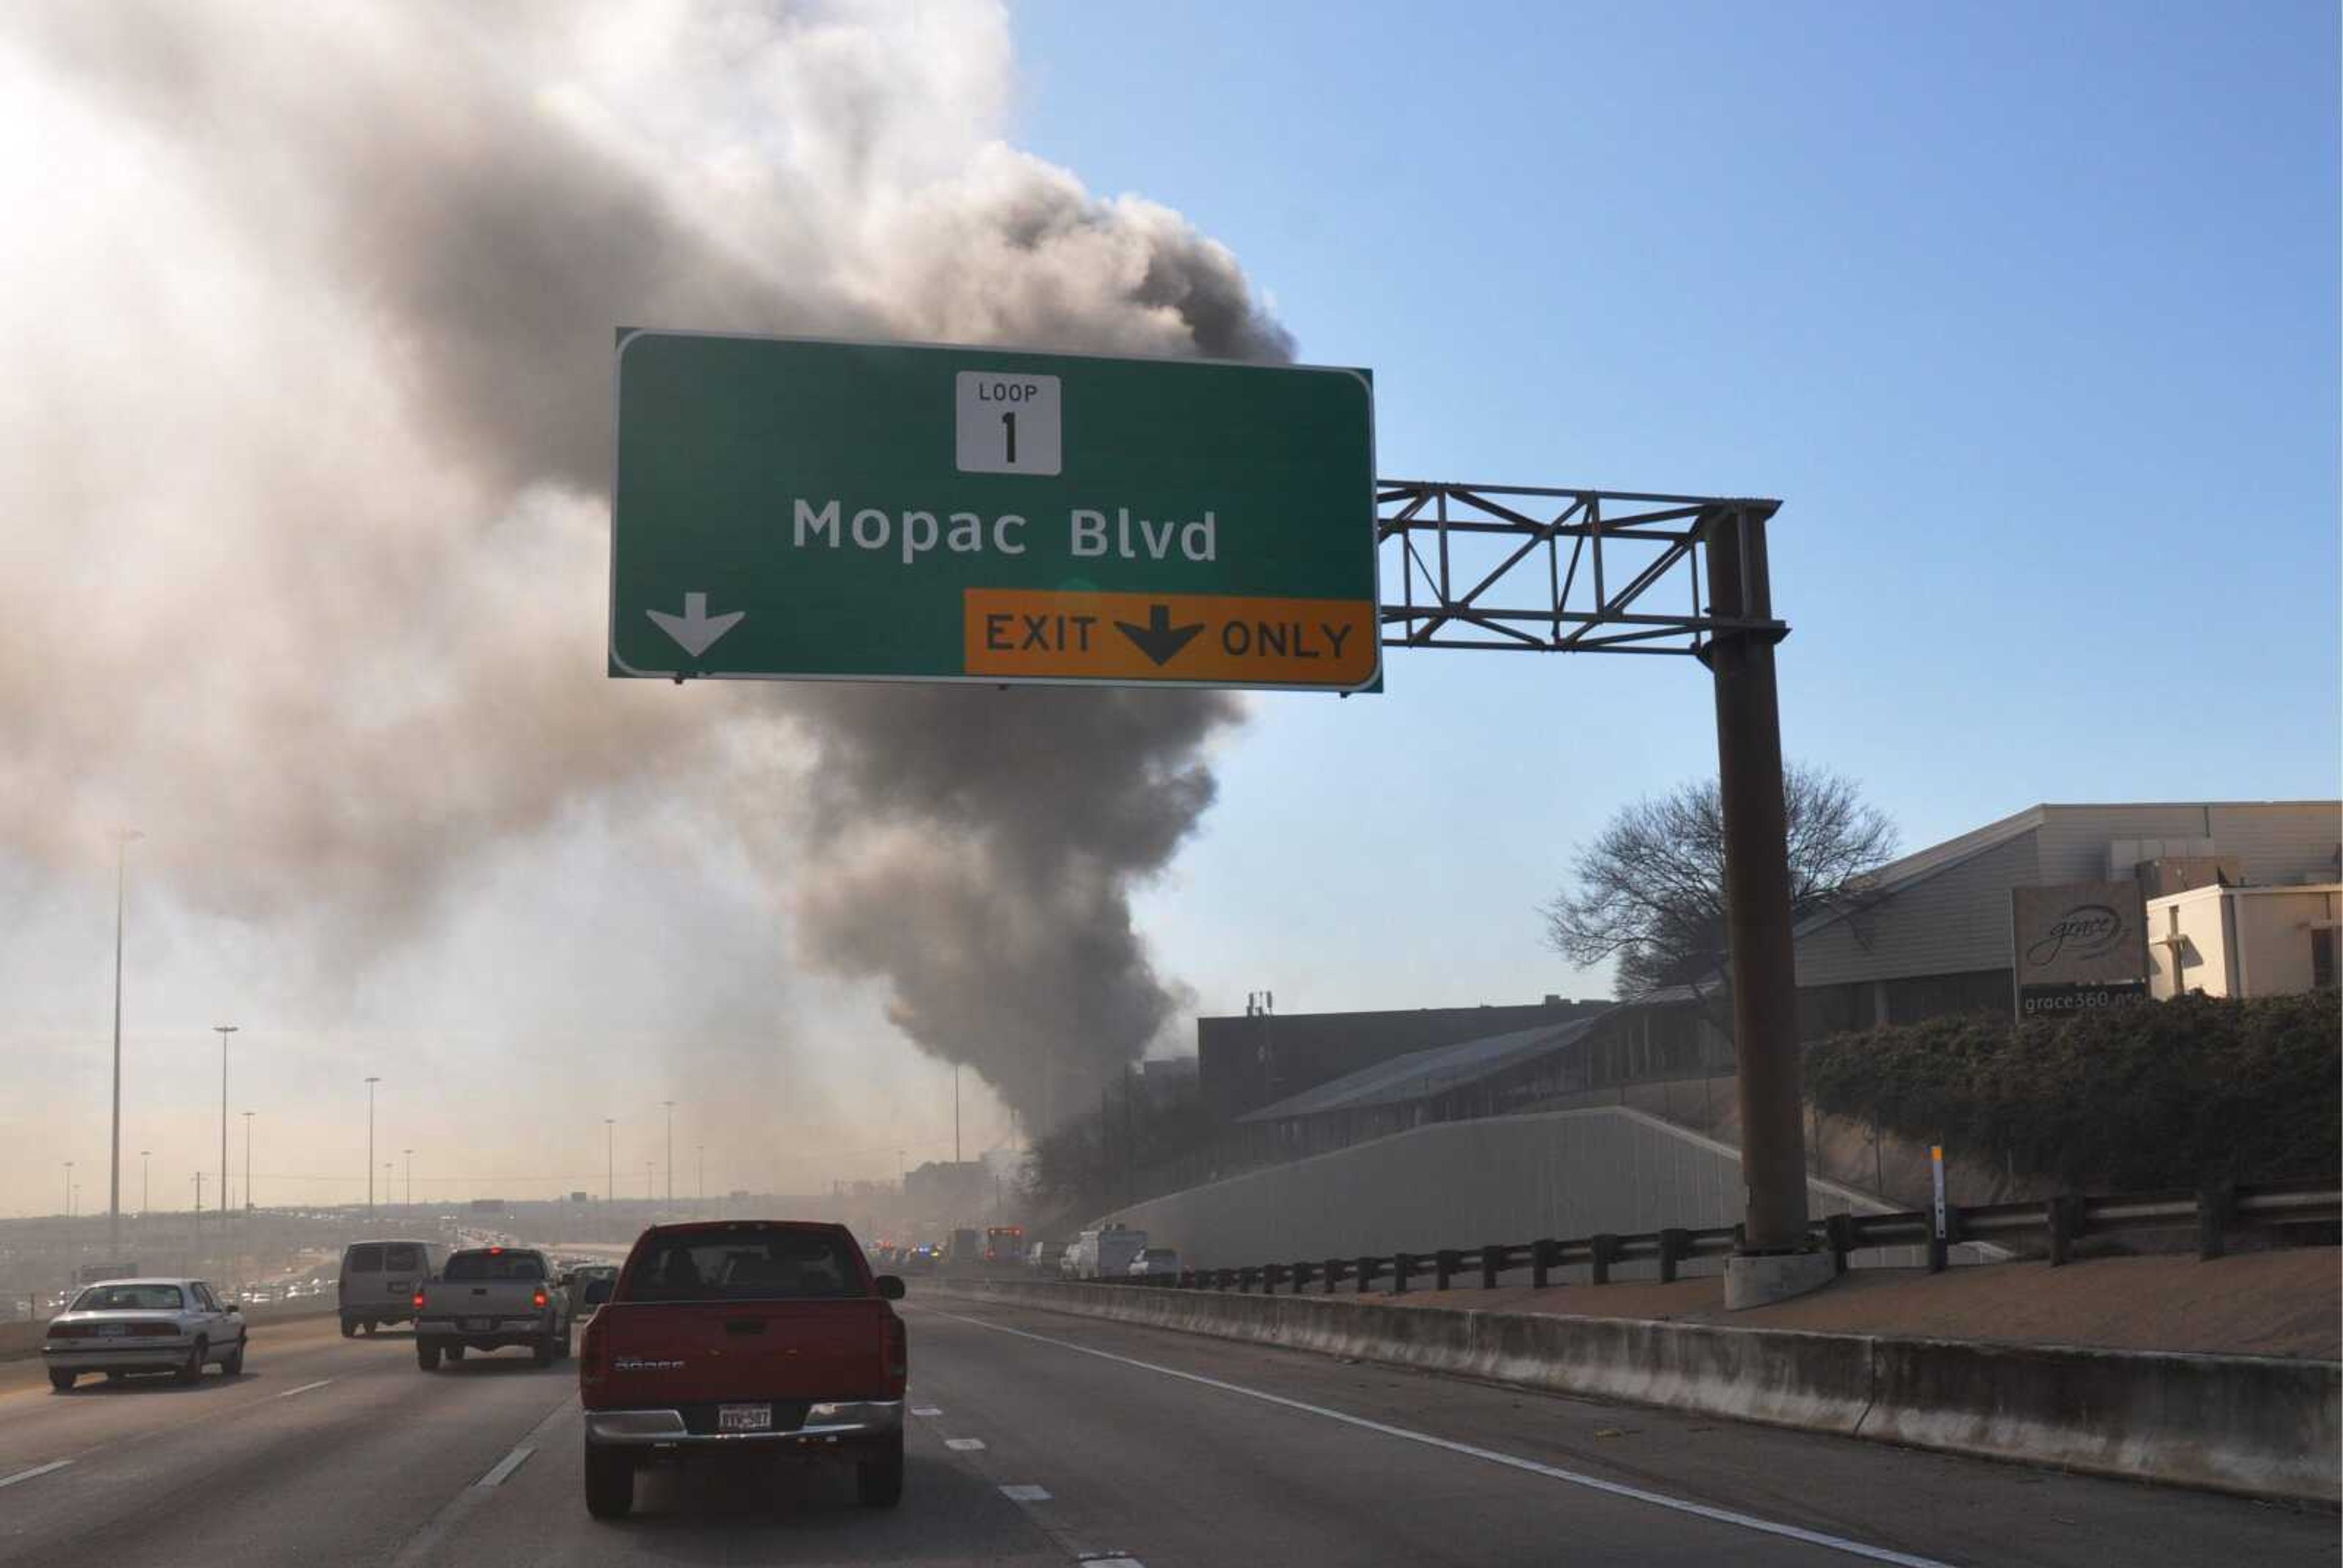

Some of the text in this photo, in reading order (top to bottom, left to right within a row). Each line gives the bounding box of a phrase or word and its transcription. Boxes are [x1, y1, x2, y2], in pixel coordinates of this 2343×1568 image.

[979, 383, 1038, 402] LOOP
[1002, 412, 1016, 463] 1
[793, 499, 1216, 564] Mopac Blvd
[986, 614, 1352, 658] EXIT ONLY
[2025, 991, 2143, 1014] grace360org
